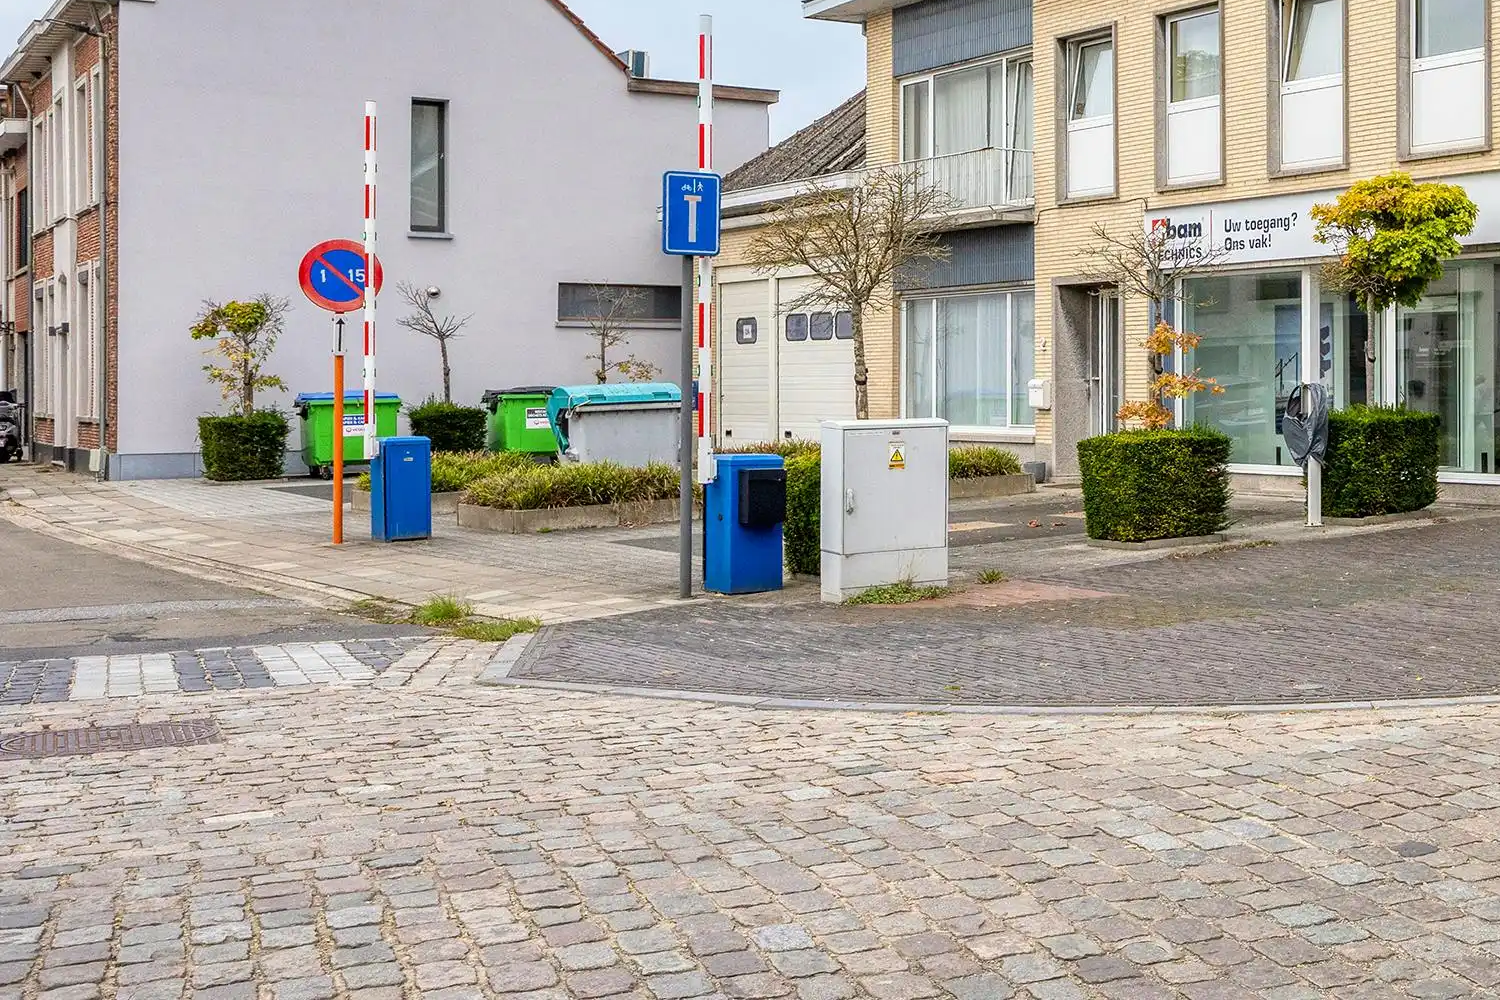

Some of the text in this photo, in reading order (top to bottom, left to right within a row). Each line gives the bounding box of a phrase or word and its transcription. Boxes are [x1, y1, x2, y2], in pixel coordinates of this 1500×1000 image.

[1167, 217, 1202, 239] bam
[1224, 212, 1298, 233] Uw toegang?
[1224, 234, 1272, 251] Ons vak!
[1153, 247, 1202, 261] ECHNICS
[320, 268, 365, 283] 1 15
